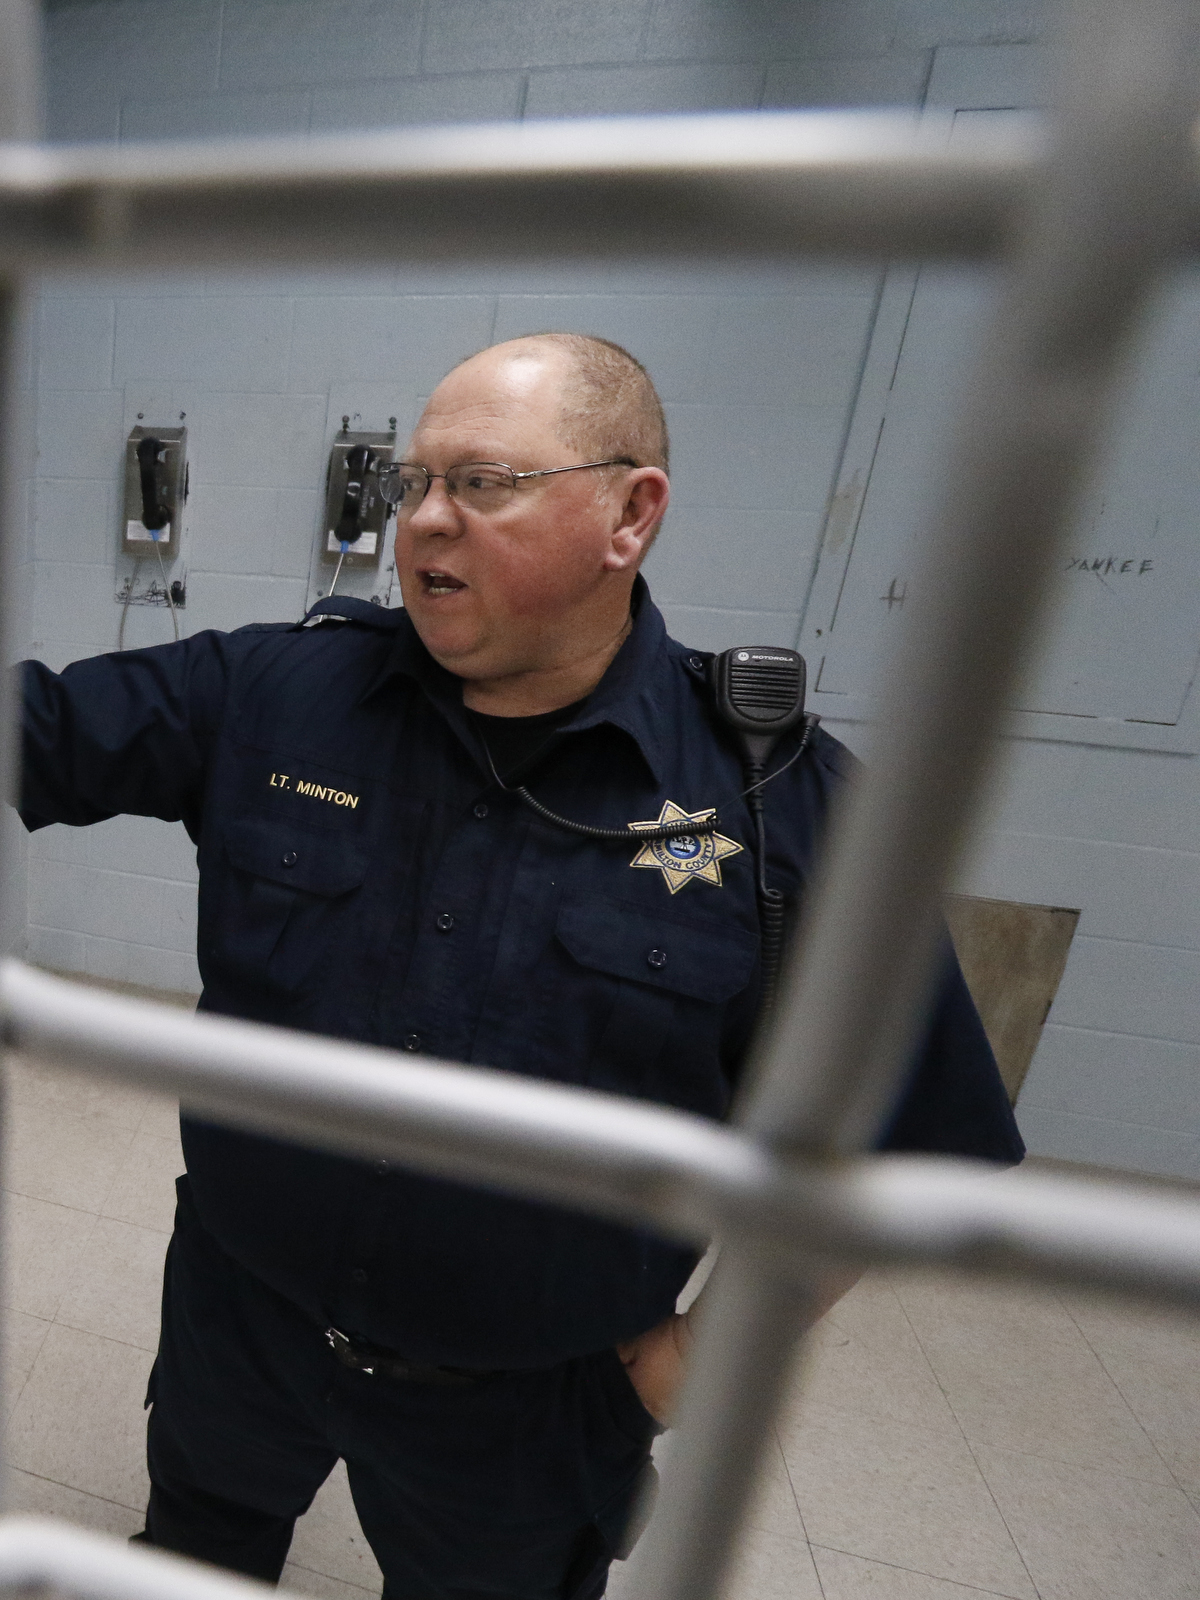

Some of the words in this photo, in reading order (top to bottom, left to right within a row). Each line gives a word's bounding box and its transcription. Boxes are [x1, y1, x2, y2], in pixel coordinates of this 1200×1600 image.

[1064, 557, 1154, 575] YANKEE
[751, 654, 794, 662] MOTOROLA
[269, 773, 290, 790] LT.
[296, 780, 359, 809] MINTON
[686, 842, 712, 870] COUNTY
